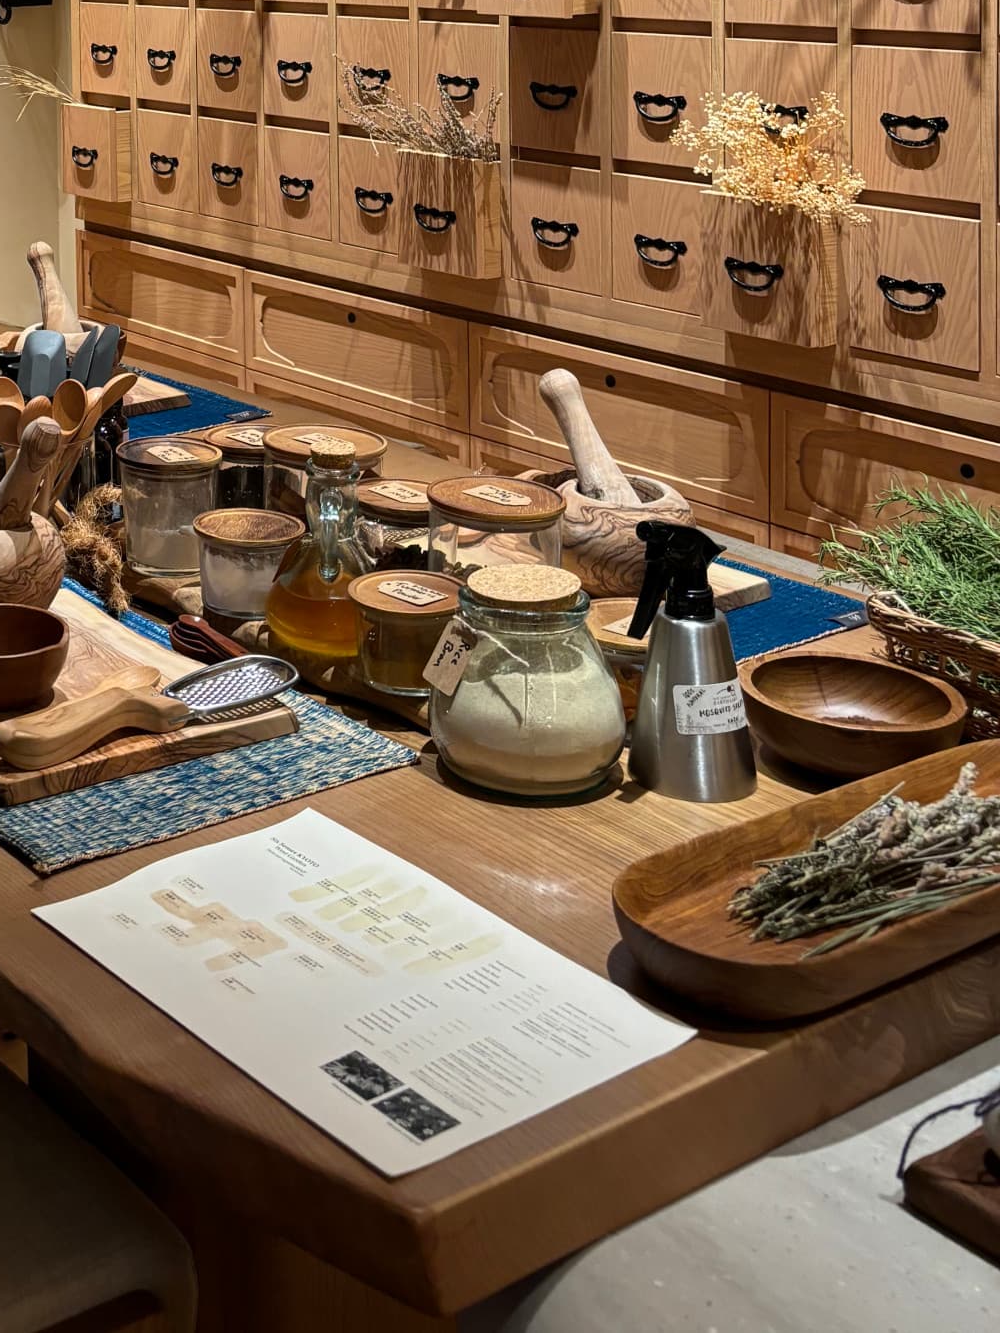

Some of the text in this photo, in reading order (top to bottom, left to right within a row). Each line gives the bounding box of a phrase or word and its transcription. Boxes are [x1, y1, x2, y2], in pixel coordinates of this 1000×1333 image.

[432, 640, 454, 667] Bran
[450, 639, 471, 665] Rice
[296, 852, 320, 868] KYOTO
